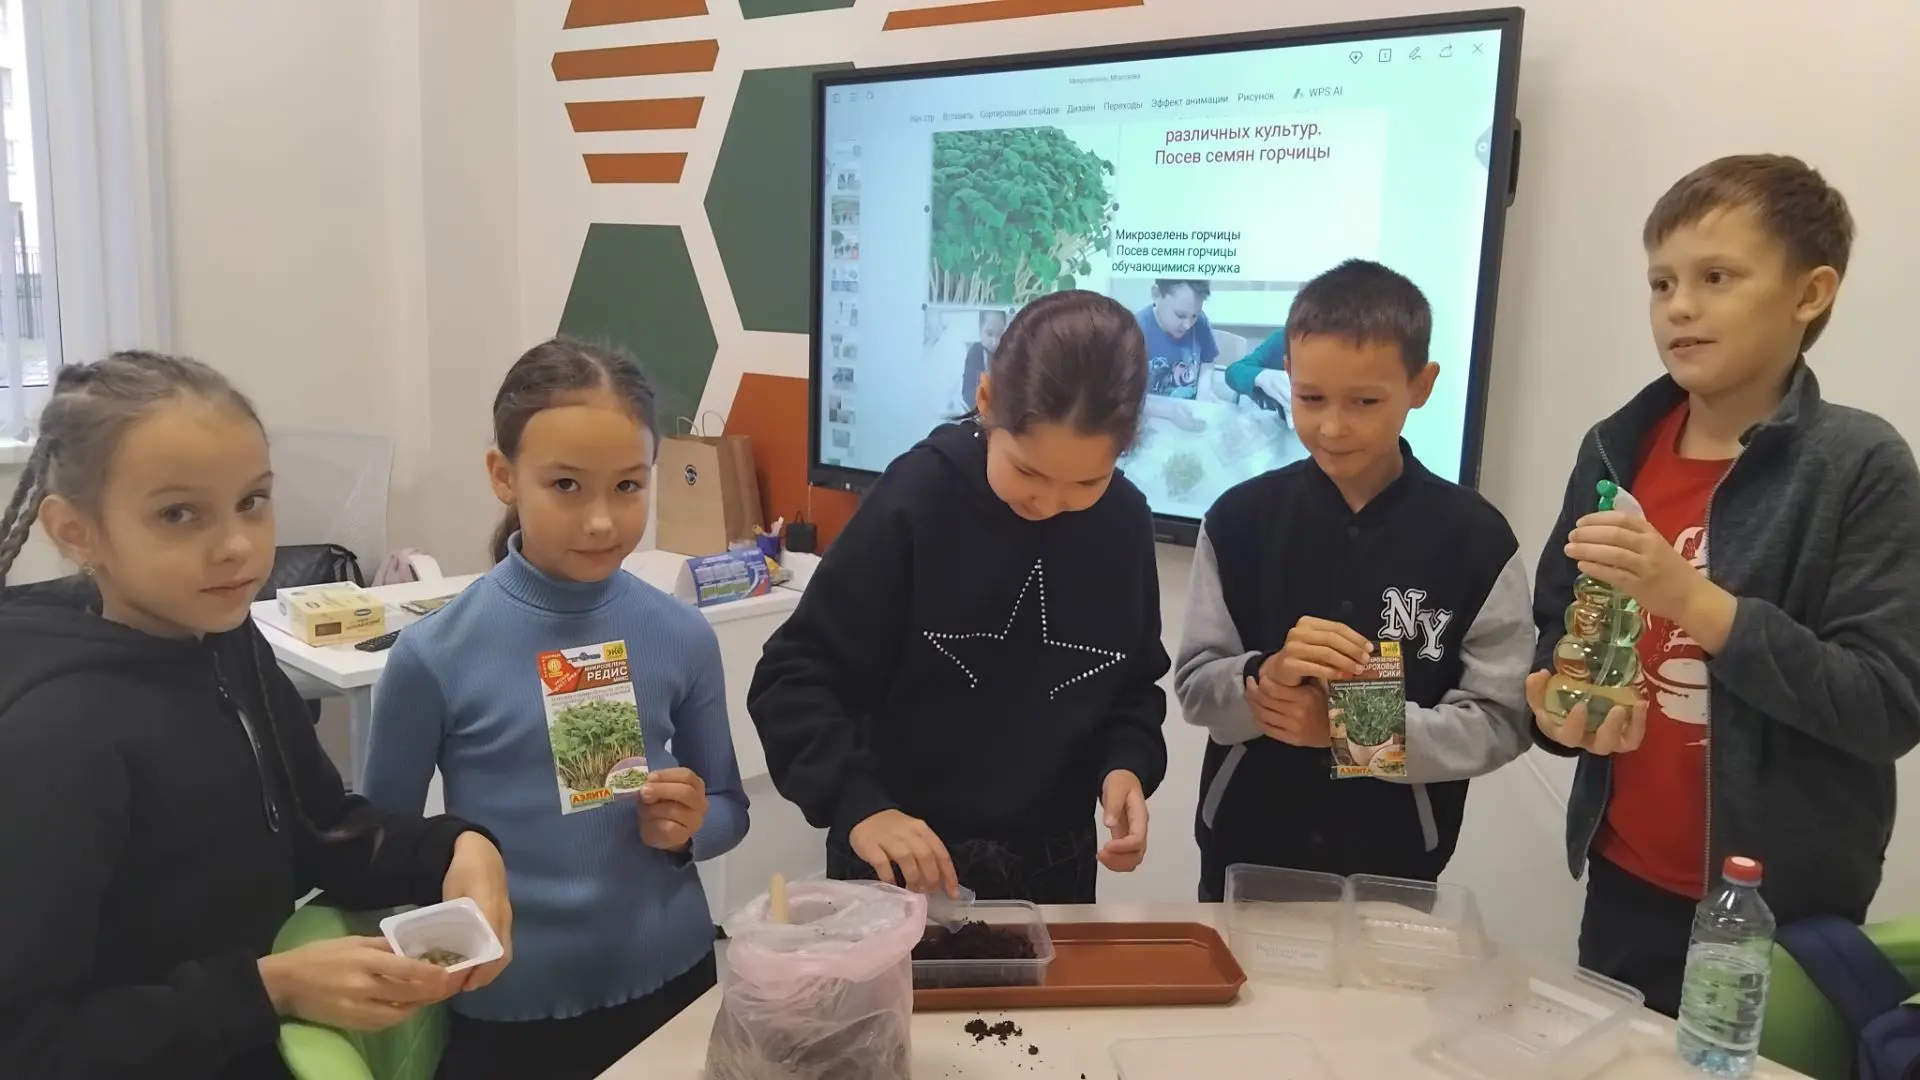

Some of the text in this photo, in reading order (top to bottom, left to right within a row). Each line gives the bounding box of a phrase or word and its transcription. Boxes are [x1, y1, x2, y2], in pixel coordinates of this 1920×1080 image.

[1237, 91, 1275, 103] Рисунок
[1308, 86, 1343, 98] WPS AI
[1103, 100, 1144, 112] Переходы
[1151, 94, 1229, 109] Эффект анимации
[1028, 105, 1060, 116] слайдов
[1066, 103, 1096, 114] Дизайн
[1165, 121, 1322, 145] различных культур.
[1155, 144, 1330, 165] Посев семян горчицы
[1115, 229, 1241, 243] Микрозелень горчицы
[1116, 245, 1237, 258] Посев семян горчицы
[1111, 260, 1241, 276] обучающимися кружка
[1378, 587, 1453, 661] NY
[584, 660, 627, 671] МИКРОЗЕЛЕНЬ
[1364, 662, 1401, 671] ОРОХОВЫЕ
[587, 665, 628, 681] РЕДИС
[1379, 670, 1401, 678] УСИКИ
[572, 789, 612, 803] АЭЛИТА
